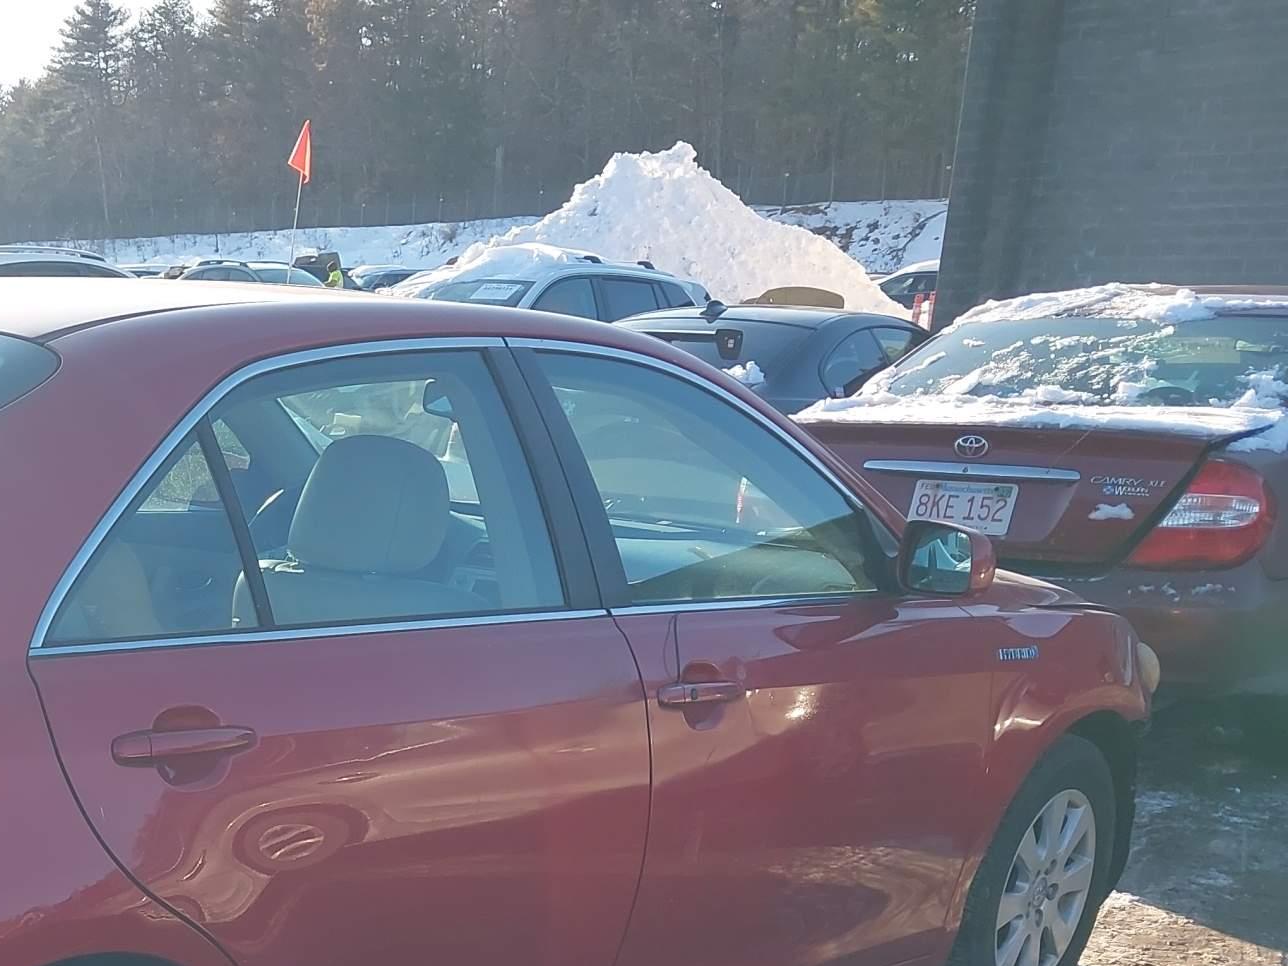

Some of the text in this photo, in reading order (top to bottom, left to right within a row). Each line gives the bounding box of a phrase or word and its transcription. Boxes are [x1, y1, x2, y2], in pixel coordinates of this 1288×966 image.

[1090, 476, 1143, 486] CAMRY
[915, 493, 1008, 522] 8KE 152
